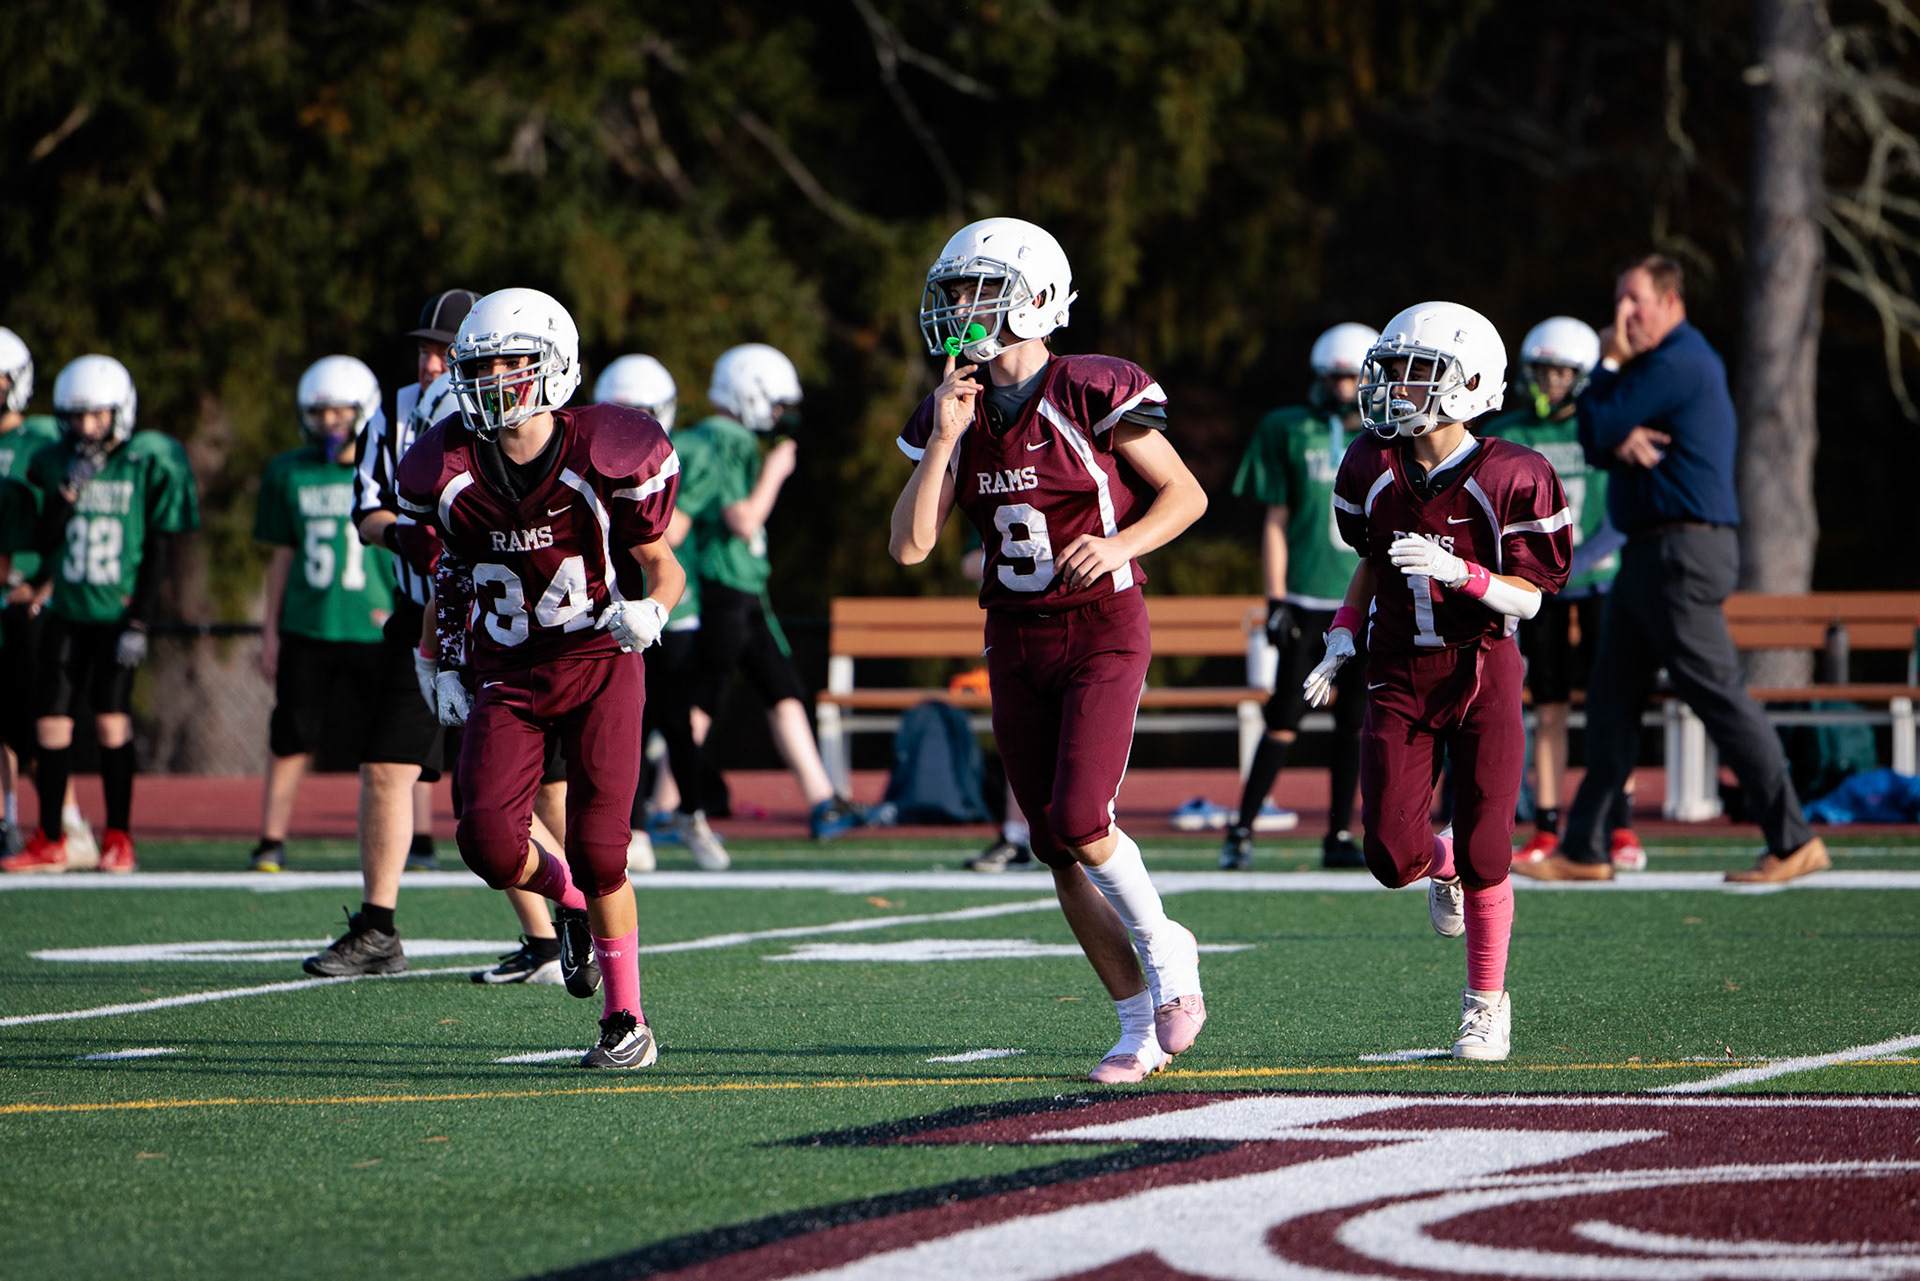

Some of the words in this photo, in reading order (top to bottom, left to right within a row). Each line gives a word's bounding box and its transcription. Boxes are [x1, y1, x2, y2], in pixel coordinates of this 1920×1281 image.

[976, 465, 1040, 495] RAMS
[304, 518, 366, 591] 51
[489, 525, 555, 553] RAMS
[993, 502, 1056, 593] 9
[471, 554, 596, 648] 34
[1406, 575, 1447, 648] 1
